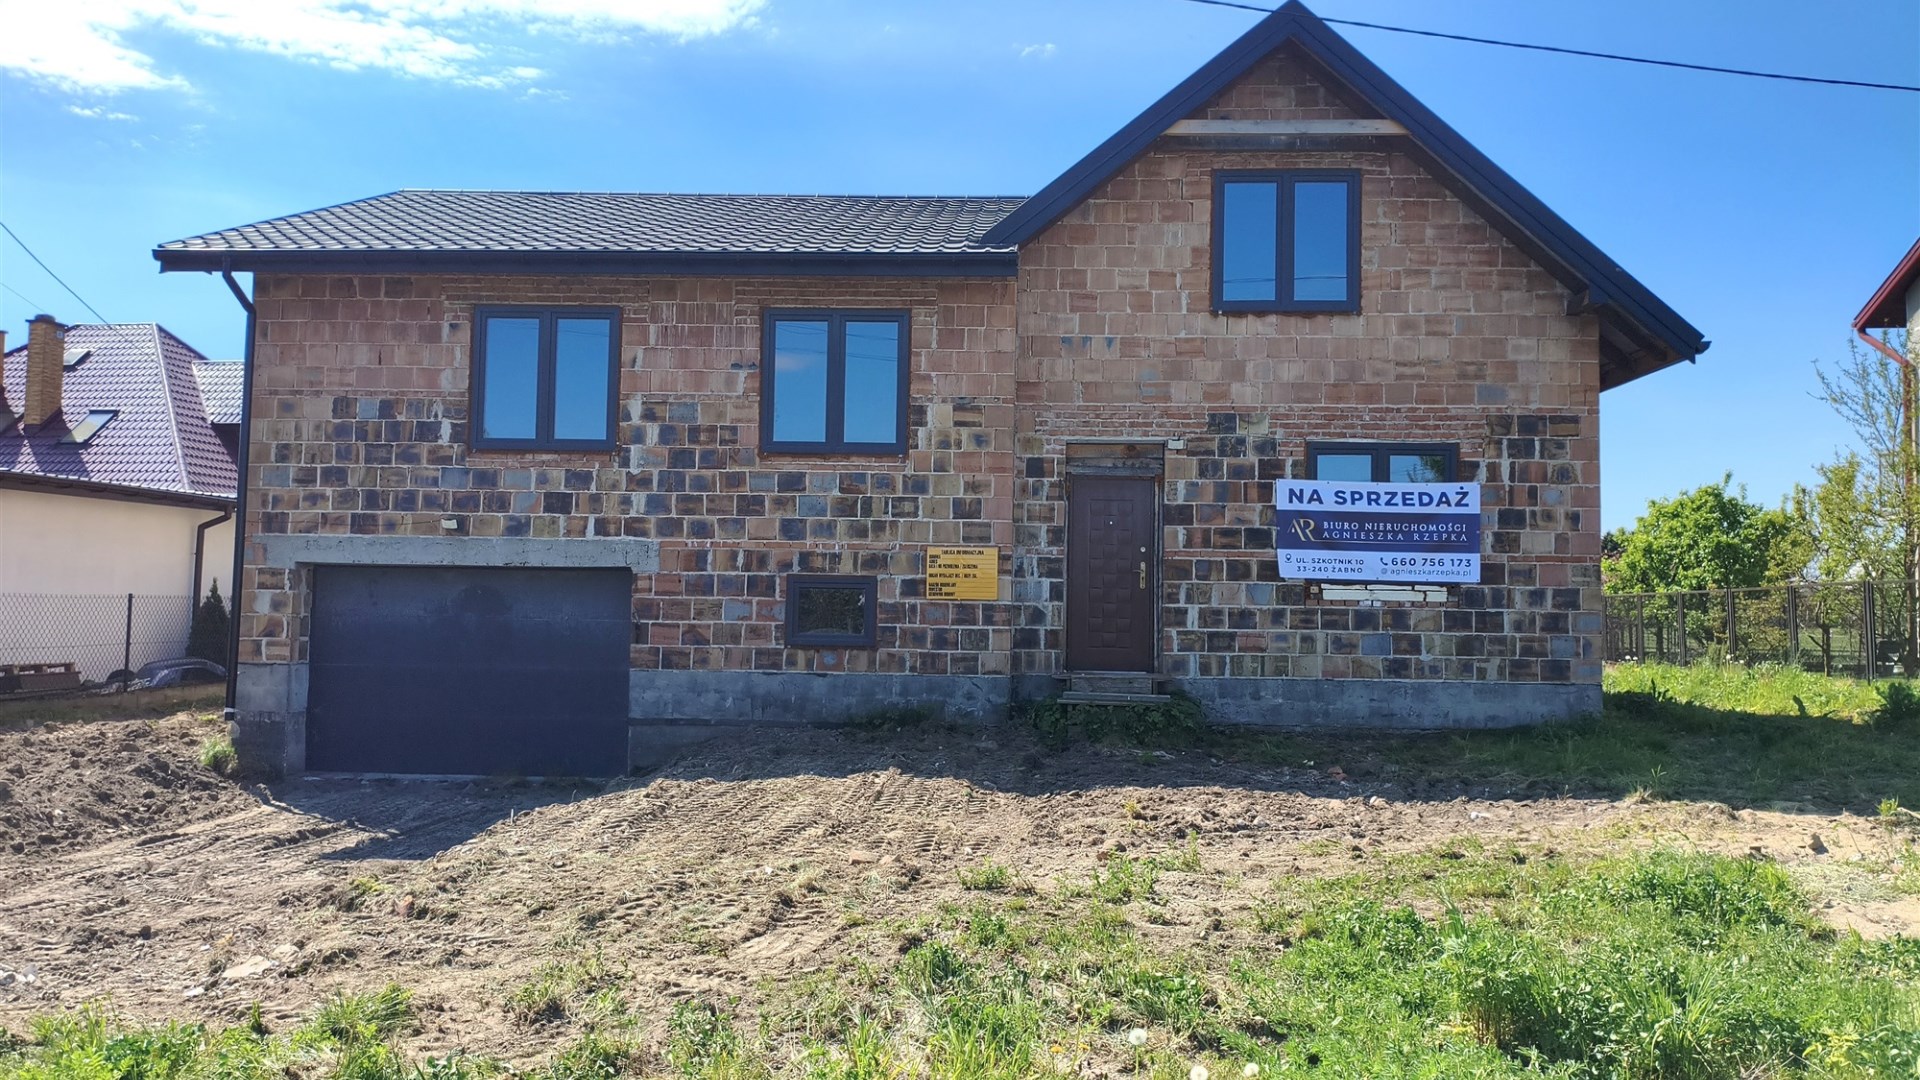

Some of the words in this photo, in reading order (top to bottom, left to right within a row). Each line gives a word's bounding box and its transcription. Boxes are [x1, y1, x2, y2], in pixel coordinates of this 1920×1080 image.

[1288, 488, 1324, 504] NA
[1334, 486, 1469, 507] SPRZEDAŻ
[1323, 521, 1359, 529] BIURO
[1364, 522, 1466, 532] NIERUCHOMOŚCI
[1323, 531, 1404, 540] AGNIESZKA
[1414, 533, 1467, 541] RZEPKA
[1392, 558, 1416, 566] 660
[1421, 558, 1446, 567] 756
[1450, 559, 1472, 567] 173
[1331, 565, 1363, 574] ŻABNO
[1390, 568, 1471, 576] agnieszkarzepka.pl
